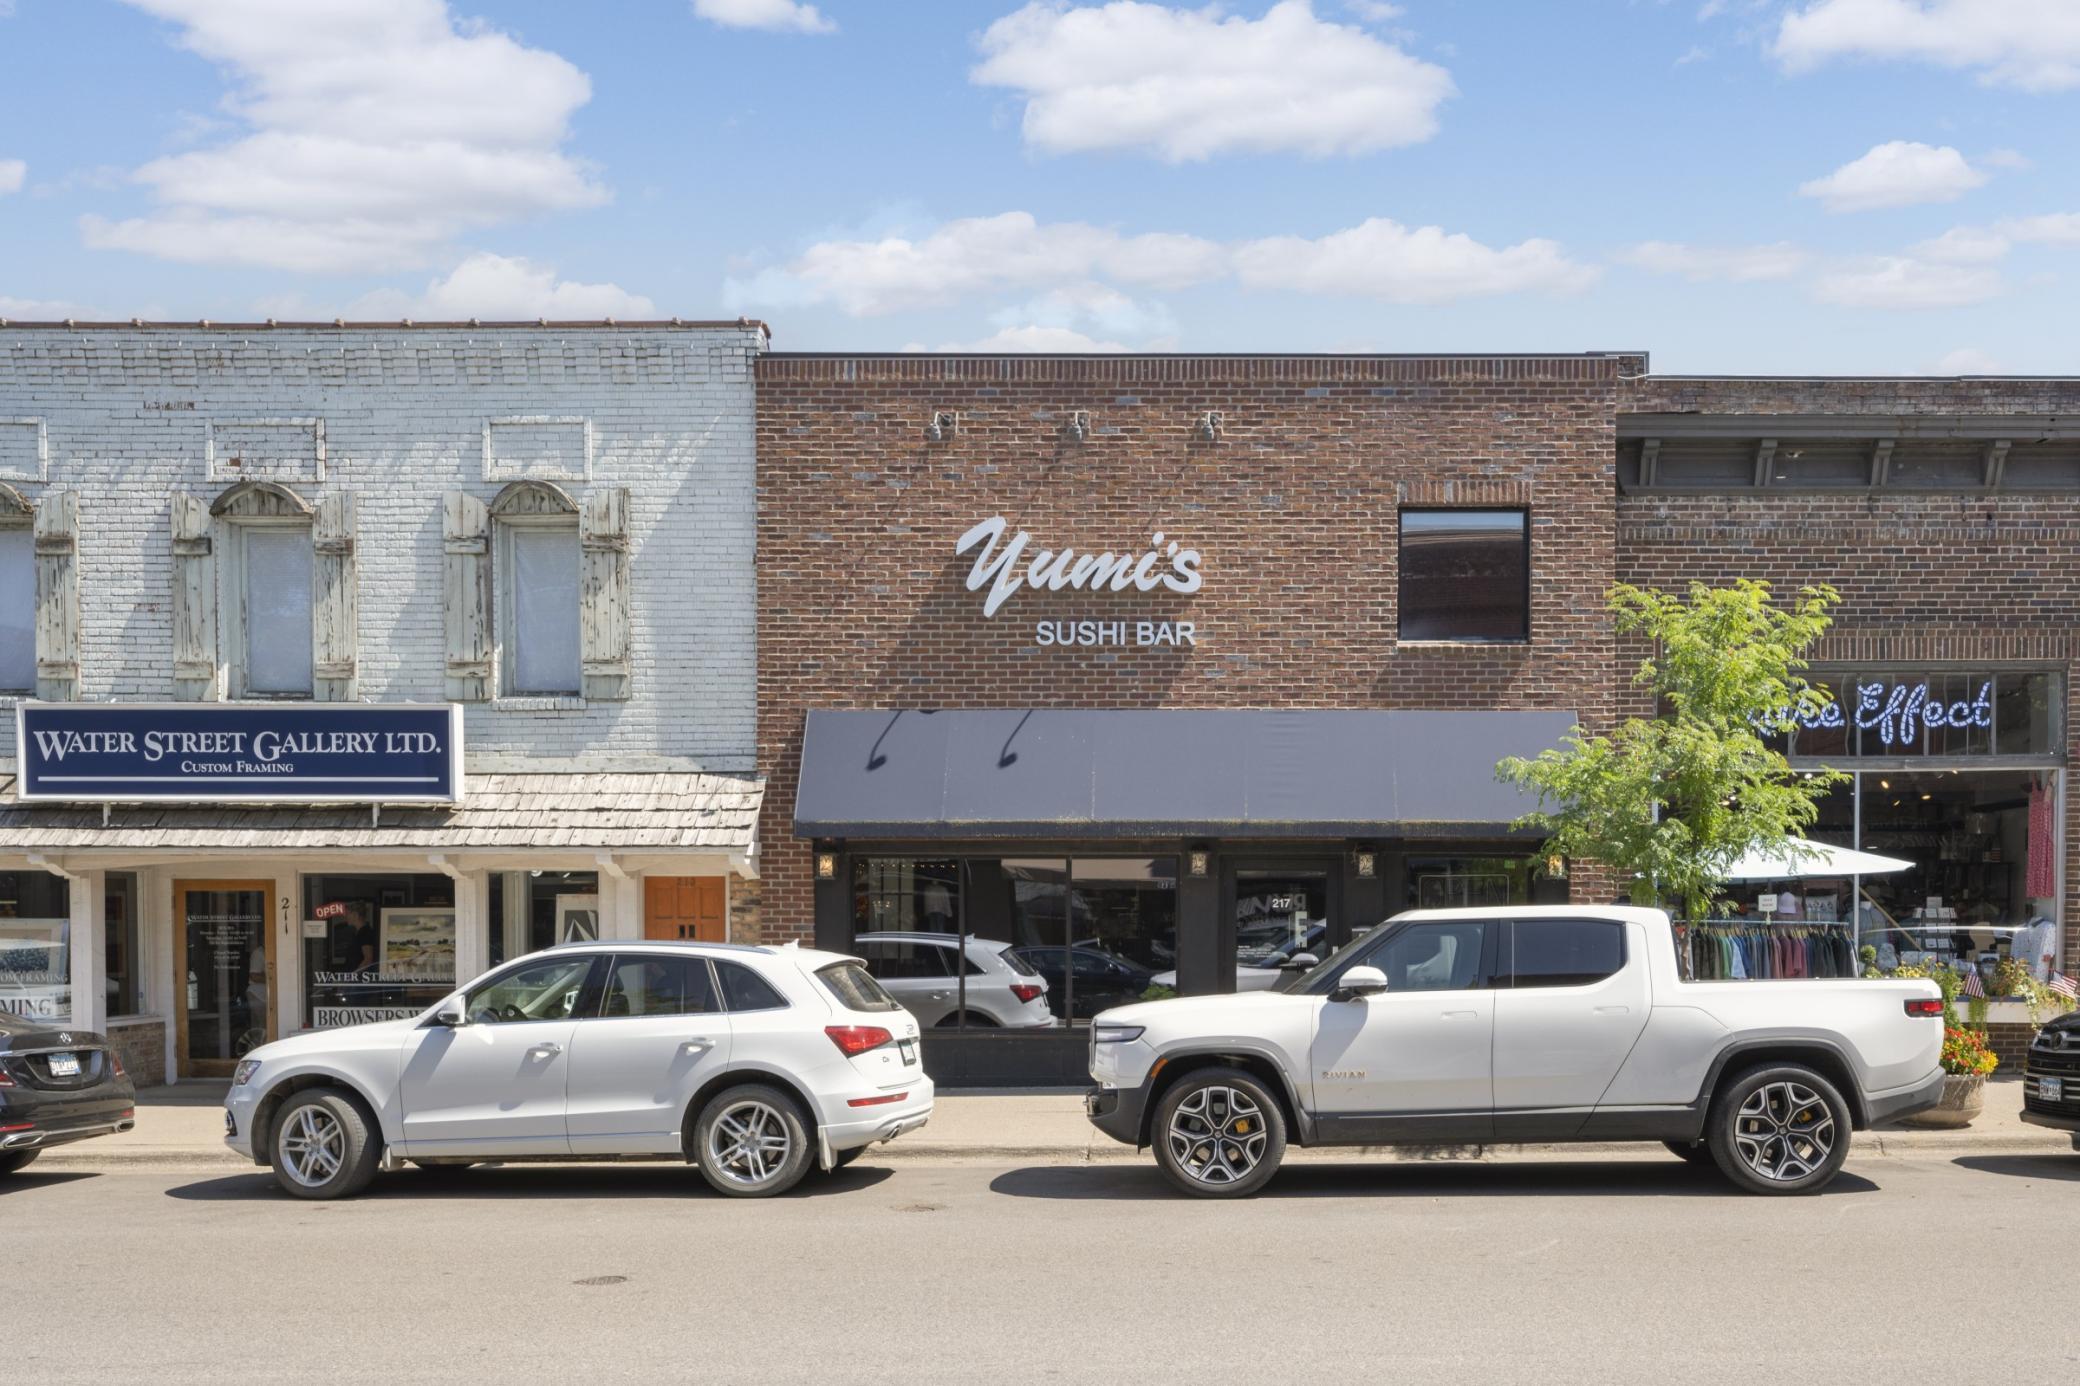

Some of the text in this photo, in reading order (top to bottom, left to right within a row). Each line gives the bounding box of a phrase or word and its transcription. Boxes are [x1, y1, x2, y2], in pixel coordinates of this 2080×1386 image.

[955, 516, 1202, 618] Yumi's
[1036, 621, 1196, 646] SUSHI BAR
[1855, 681, 1992, 745] Effect
[33, 731, 442, 762] WATER STREET GALLERY LTD.
[181, 760, 294, 773] CUSTOM FRAMING
[1272, 898, 1291, 908] 217
[316, 904, 344, 918] OPEN
[20, 973, 68, 983] FRAMING
[314, 971, 359, 984] WATER
[318, 1009, 404, 1027] BROWSERS
[1322, 1071, 1366, 1080] RIVIAN
